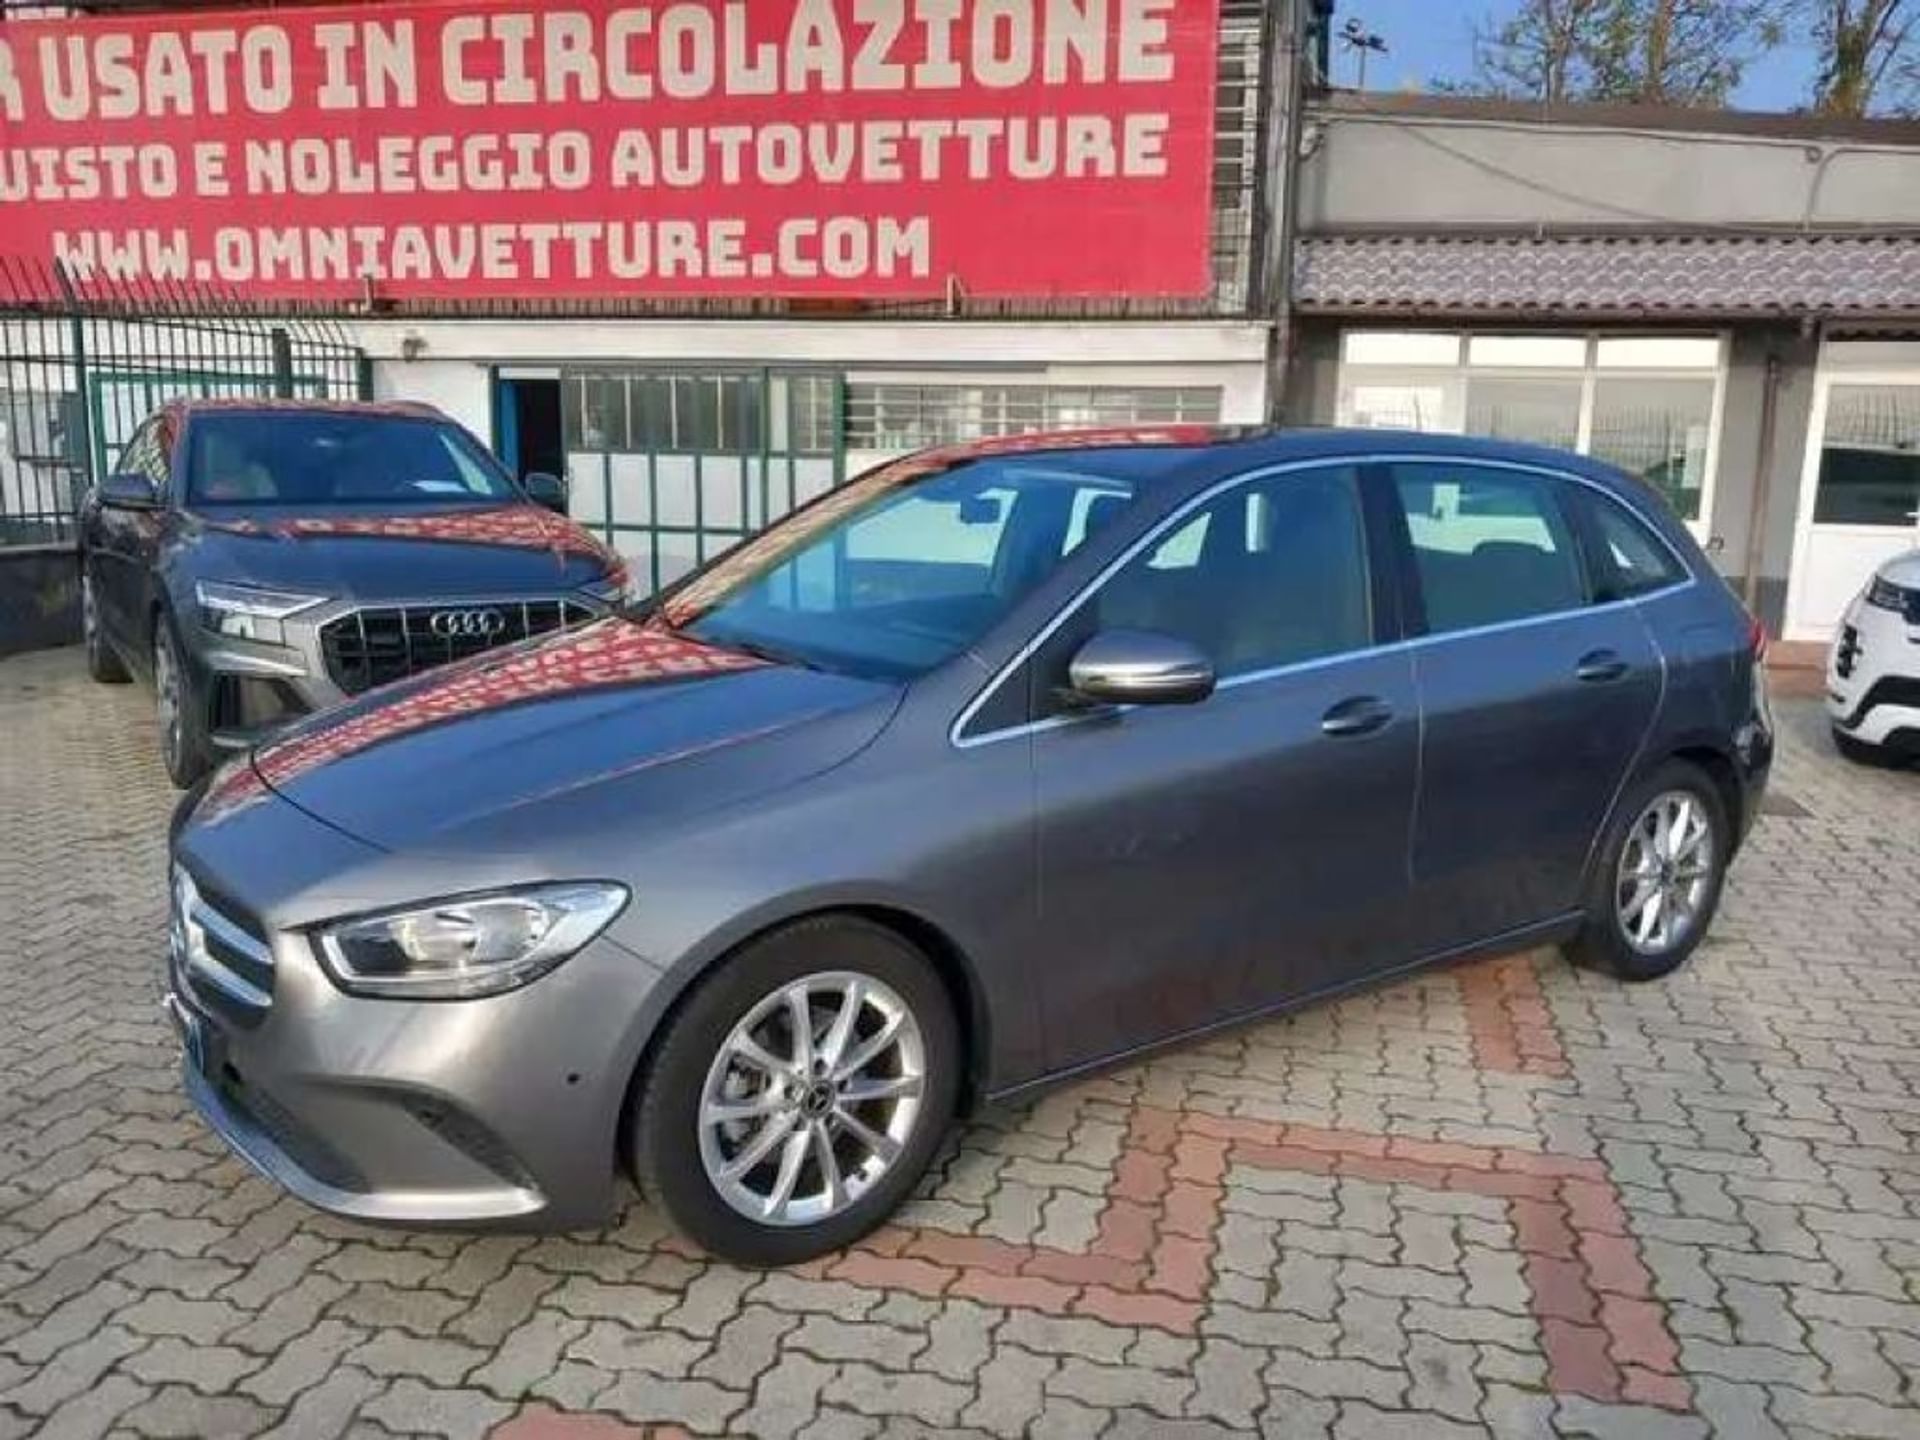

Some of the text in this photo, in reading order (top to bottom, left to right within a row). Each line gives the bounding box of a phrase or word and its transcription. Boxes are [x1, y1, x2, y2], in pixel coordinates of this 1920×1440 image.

[38, 26, 292, 121] USATO
[315, 21, 417, 108] IN
[441, 0, 1174, 104] CIRCOLAZIONE
[194, 142, 230, 195] E
[245, 131, 591, 194] NOLEGGIO
[611, 113, 1169, 187] AUTOVETTURE
[52, 217, 930, 281] WWW.OMNIAVETTURE.COM
